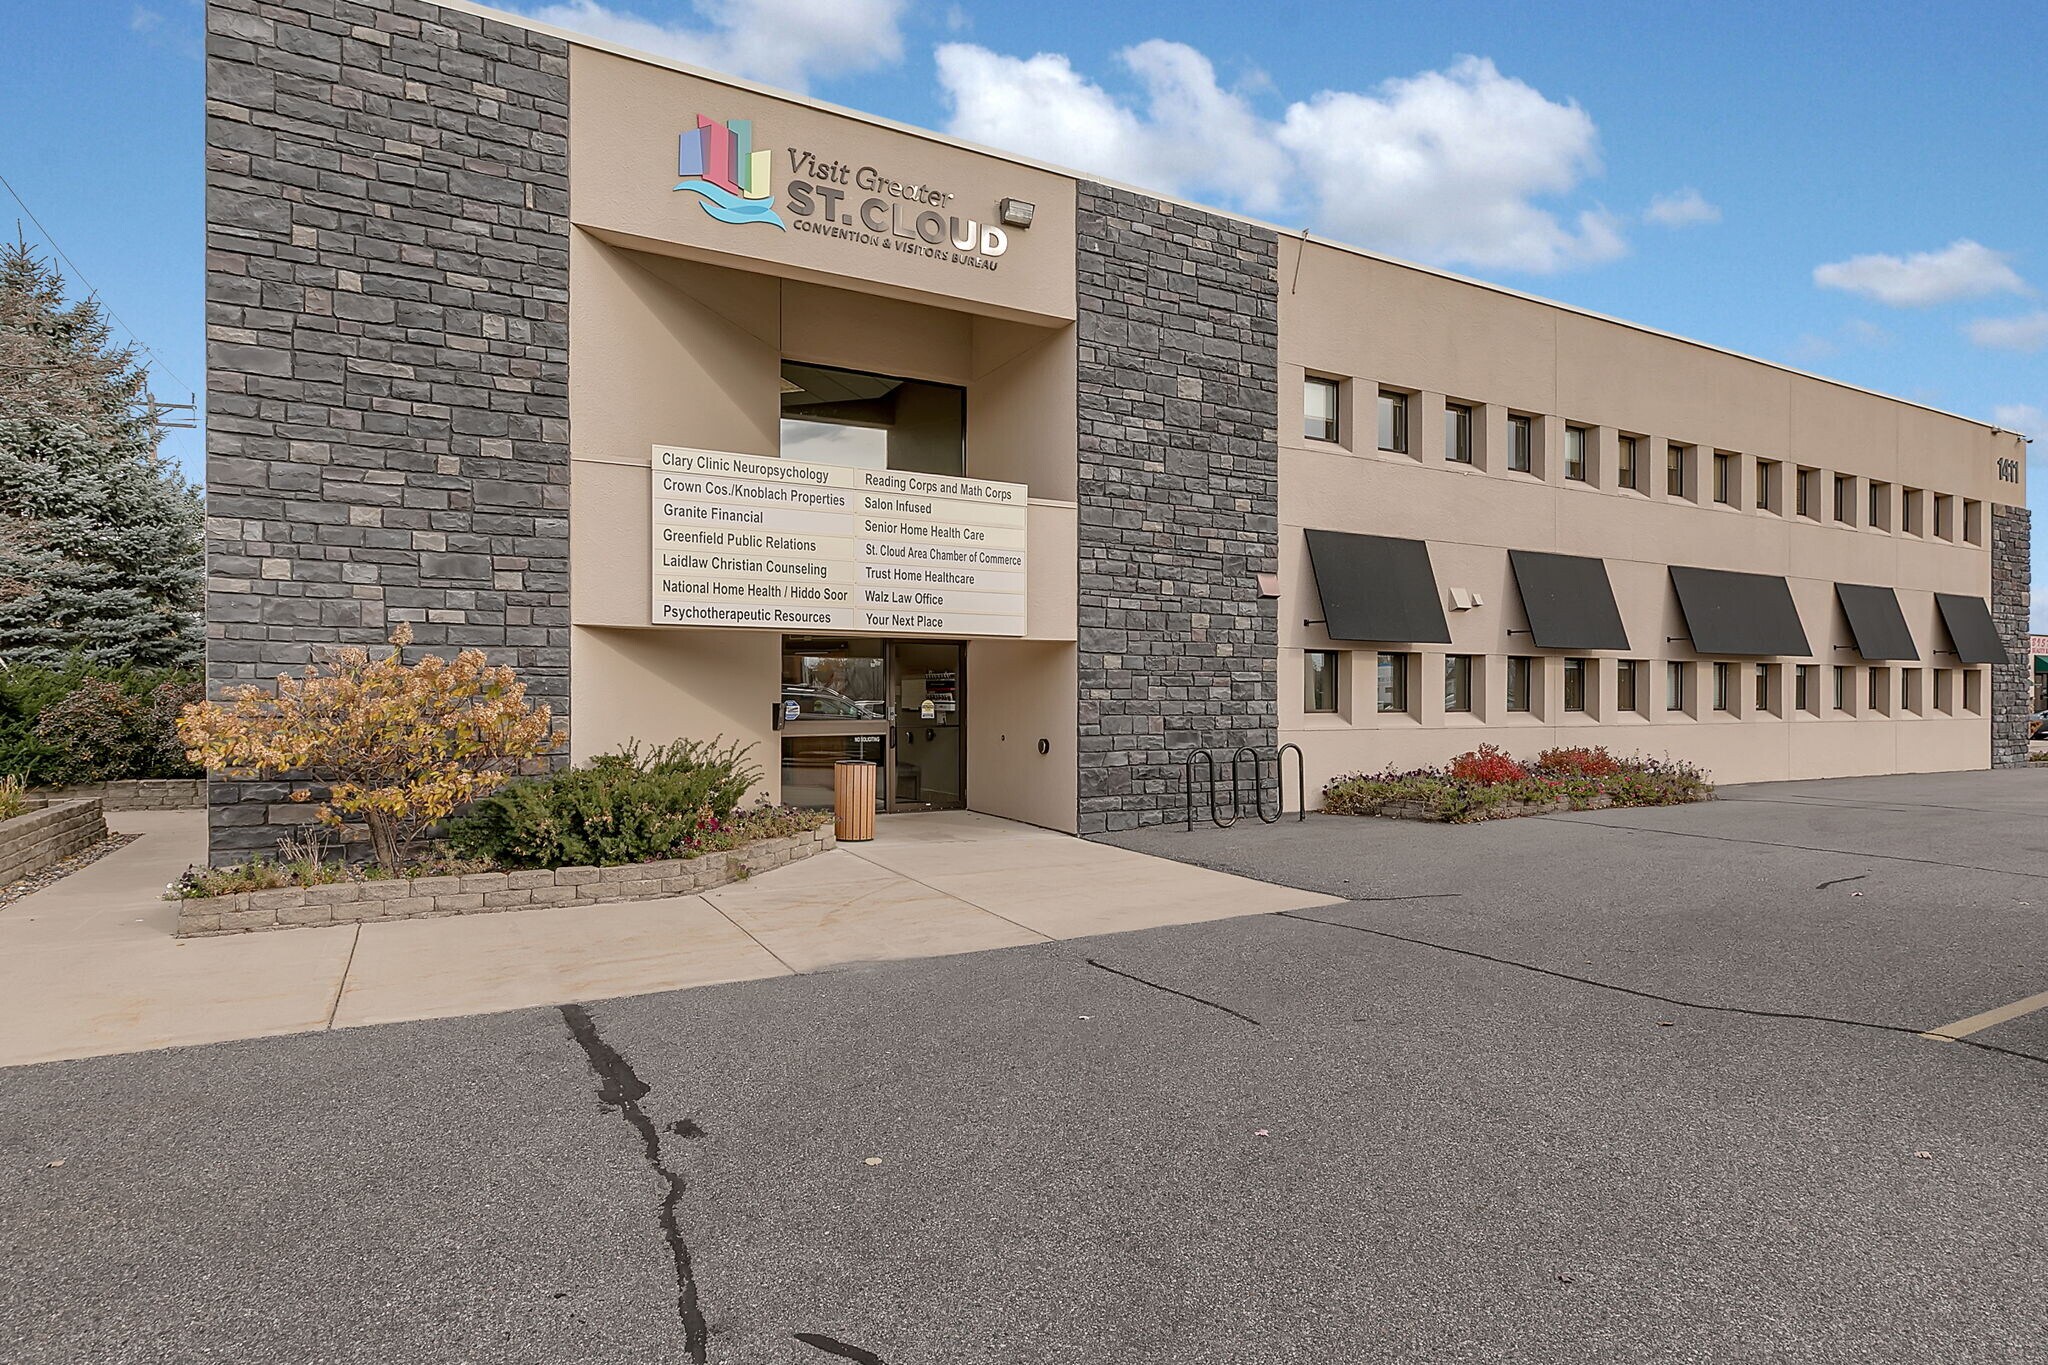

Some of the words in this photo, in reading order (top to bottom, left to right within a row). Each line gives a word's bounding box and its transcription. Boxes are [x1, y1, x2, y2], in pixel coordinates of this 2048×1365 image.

[788, 148, 850, 185] Visit
[856, 166, 955, 208] Greater
[787, 180, 852, 226] ST.
[860, 198, 1008, 257] CLOUD
[794, 220, 879, 246] CONVENTION
[883, 238, 891, 249] &
[895, 240, 948, 260] VISITORS
[952, 253, 998, 271] BUREAU
[662, 453, 693, 470] Clary
[697, 456, 729, 471] Clinic
[733, 460, 829, 483] Neuropsychology
[1997, 457, 2018, 484] 1411
[663, 478, 701, 493] Crown
[705, 482, 787, 501] Cos./Knoblach
[791, 489, 845, 506] Properties
[865, 473, 906, 491] Reading
[909, 478, 937, 493] Corps
[940, 482, 957, 493] and
[960, 484, 982, 497] Math
[985, 487, 1012, 501] Corps
[664, 504, 707, 519] Granite
[711, 508, 763, 523] Financial
[865, 497, 893, 511] Salon
[896, 499, 932, 514] Infused
[663, 529, 724, 545] Greenfield
[727, 533, 762, 548] Public
[766, 537, 816, 551] Relations
[865, 520, 897, 534] Senior
[900, 523, 928, 536] Home
[931, 526, 960, 539] Health
[963, 528, 984, 540] Care
[663, 554, 708, 569] Laidlaw
[712, 557, 763, 572] Christian
[766, 560, 827, 578] Counseling
[866, 544, 878, 556] St.
[880, 545, 906, 557] Cloud
[908, 547, 927, 559] Area
[930, 549, 966, 562] Chamber
[969, 552, 977, 563] of
[979, 553, 1021, 566] Commerce
[866, 567, 891, 580] Trust
[894, 569, 921, 582] Home
[924, 571, 975, 585] Healthcare
[663, 580, 709, 594] National
[713, 582, 744, 596] Home
[748, 584, 781, 597] Health
[784, 586, 787, 597] /
[791, 586, 821, 599] Hiddo
[824, 588, 848, 601] Soor
[865, 590, 889, 603] Walz
[892, 592, 912, 604] Law
[914, 592, 943, 605] Office
[663, 605, 771, 622] Psychotherapeutic
[774, 609, 831, 623] Resources
[866, 613, 889, 626] Your
[892, 614, 914, 626] Next
[917, 615, 943, 627] Place
